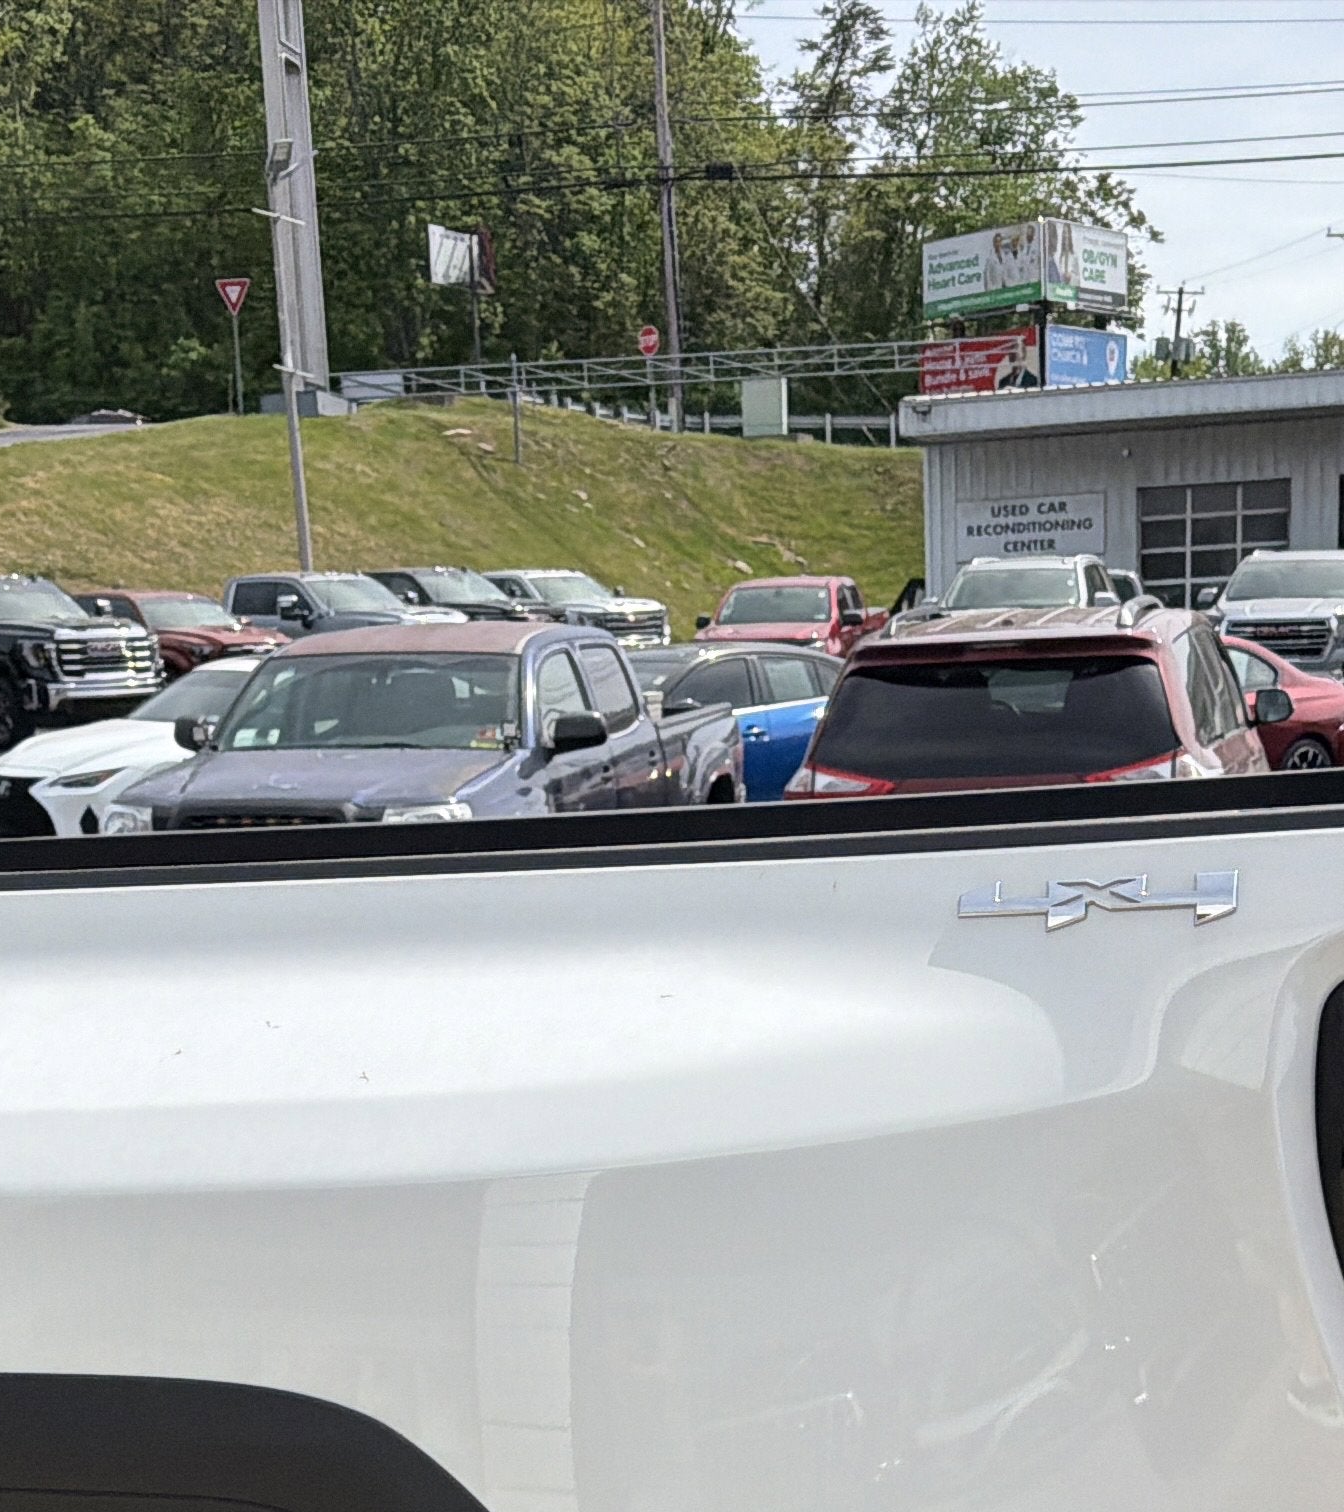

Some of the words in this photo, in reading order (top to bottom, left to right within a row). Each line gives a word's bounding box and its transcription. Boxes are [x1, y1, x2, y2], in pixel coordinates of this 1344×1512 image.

[928, 253, 980, 275] Advanced
[928, 275, 956, 291] Heart
[957, 271, 982, 286] Care
[1082, 267, 1106, 284] CARE
[991, 504, 1030, 518] USED
[1037, 501, 1067, 514] CAR
[966, 517, 1094, 537] RECONDITIONING
[1003, 539, 1056, 553] CENTER
